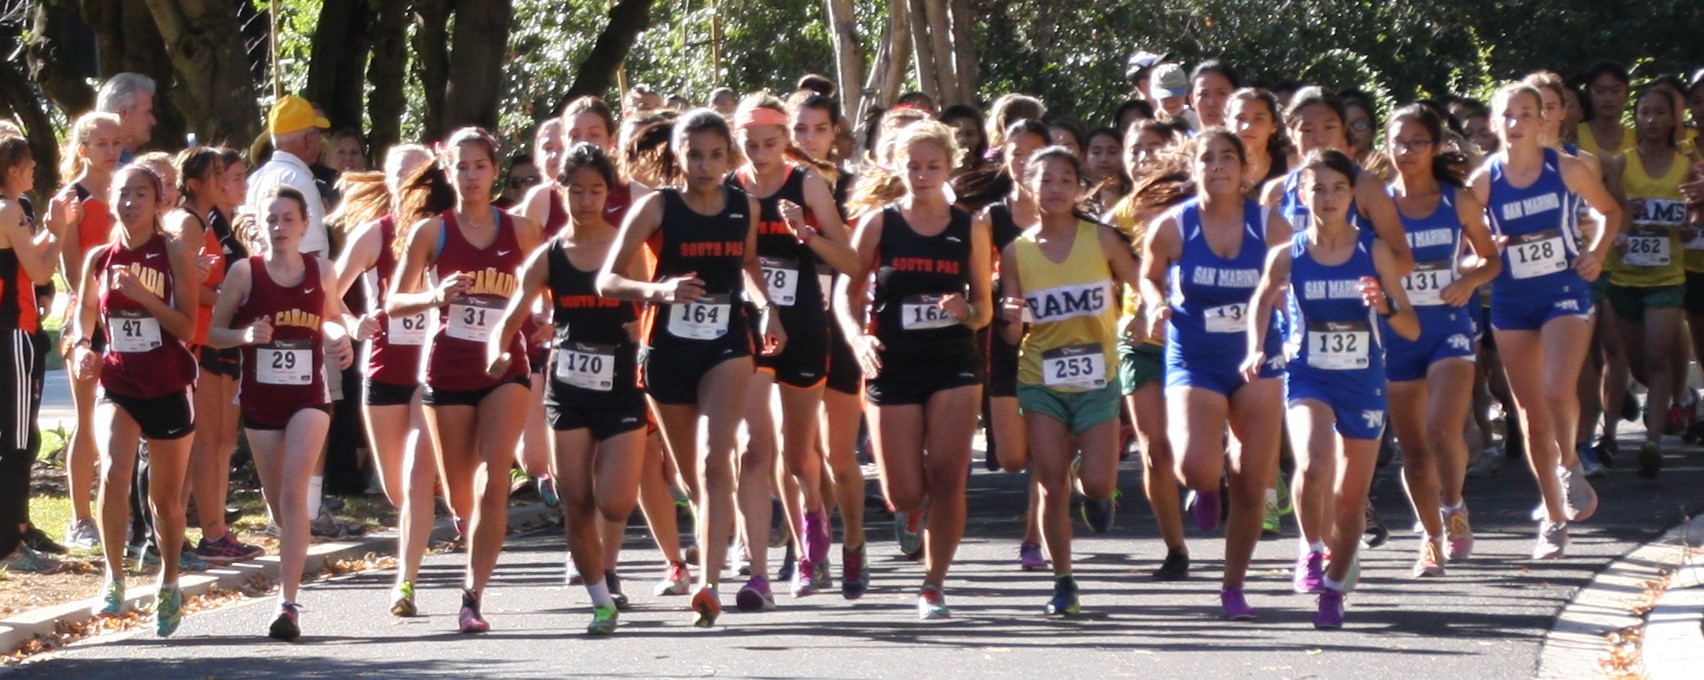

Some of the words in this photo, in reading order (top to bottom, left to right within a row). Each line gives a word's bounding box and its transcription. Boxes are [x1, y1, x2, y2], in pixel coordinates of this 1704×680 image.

[1503, 201, 1523, 220] SAN
[1522, 192, 1560, 216] MARINO
[1414, 227, 1453, 248] MARINO
[1630, 238, 1661, 254] 262
[680, 241, 721, 257] SOUTH
[1518, 241, 1554, 263] 128
[892, 257, 933, 272] SOUTH
[937, 259, 960, 275] PAS
[1193, 265, 1217, 286] SAN
[1305, 280, 1326, 300] SAN
[1406, 271, 1439, 290] 131
[402, 313, 425, 331] 62
[463, 307, 486, 326] 31
[682, 304, 719, 323] 164
[1217, 304, 1248, 321] 13
[122, 319, 142, 337] 47
[1320, 333, 1357, 352] 132
[272, 351, 296, 369] 29
[568, 352, 602, 374] 170
[1055, 357, 1093, 379] 253
